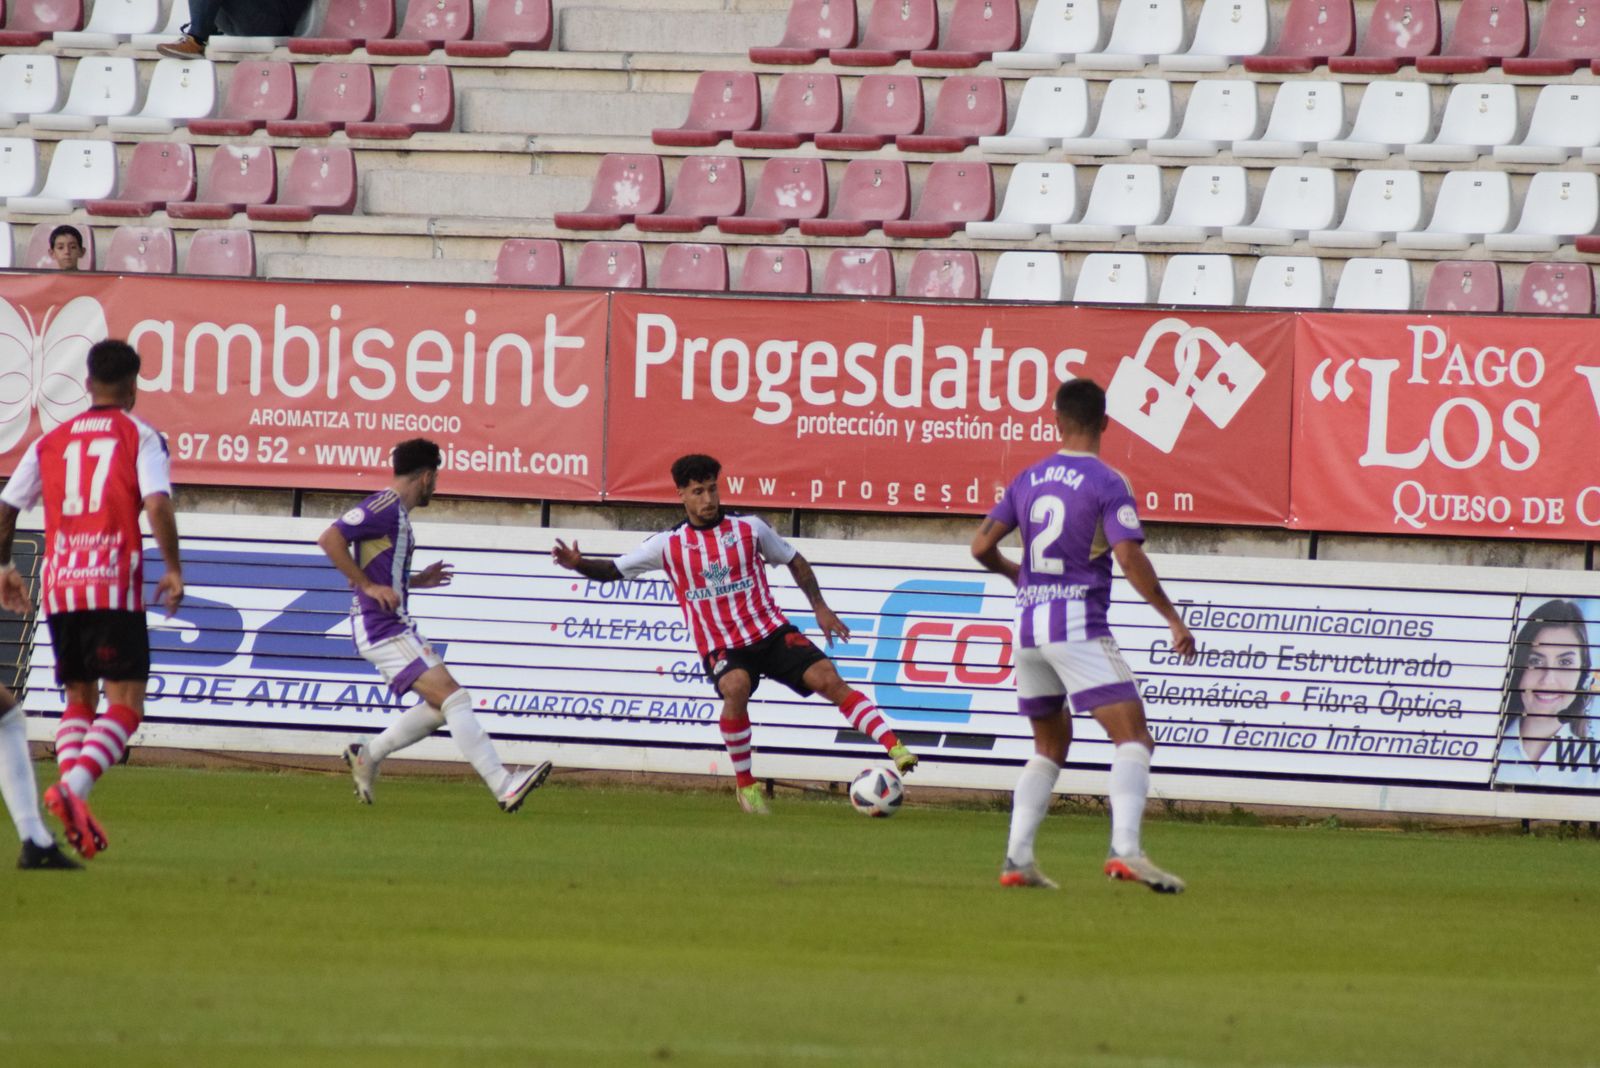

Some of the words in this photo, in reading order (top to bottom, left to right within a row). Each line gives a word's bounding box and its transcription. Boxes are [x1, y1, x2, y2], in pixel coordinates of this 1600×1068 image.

[128, 304, 589, 408] ambiseint
[634, 313, 1087, 425] Progesdatos
[1406, 325, 1545, 388] PAGO
[70, 417, 113, 435] NAHUEL
[250, 408, 350, 429] AROMATIZA
[355, 412, 379, 430] TU
[382, 413, 461, 433] NEGOCIO
[797, 411, 898, 438] protección
[904, 418, 916, 443] y
[921, 414, 993, 444] gestión
[1000, 416, 1023, 441] de
[1030, 417, 1063, 442] dat
[177, 432, 210, 460] 97
[217, 434, 250, 462] 69
[256, 436, 289, 464] 52
[315, 443, 589, 476] www.iseint.com
[62, 437, 118, 516] 17
[1392, 480, 1511, 528] QUESO
[1029, 494, 1066, 575] 2
[584, 578, 675, 602] FONTAN
[685, 589, 713, 601] CAJA
[715, 578, 755, 596] RURAL
[563, 617, 691, 643] CALEFACCI
[1177, 598, 1434, 639] Telecomunicaciones
[671, 660, 714, 684] GA
[1276, 644, 1453, 678] Estructurado
[180, 675, 236, 706] DE
[1302, 685, 1369, 715] Fibra
[1377, 680, 1463, 723] Óptica
[493, 693, 603, 718] CUARTOS
[609, 697, 643, 723] DE
[647, 698, 715, 727] BAÑO
[1219, 719, 1317, 749] Técnico
[1326, 723, 1479, 757] Informático
